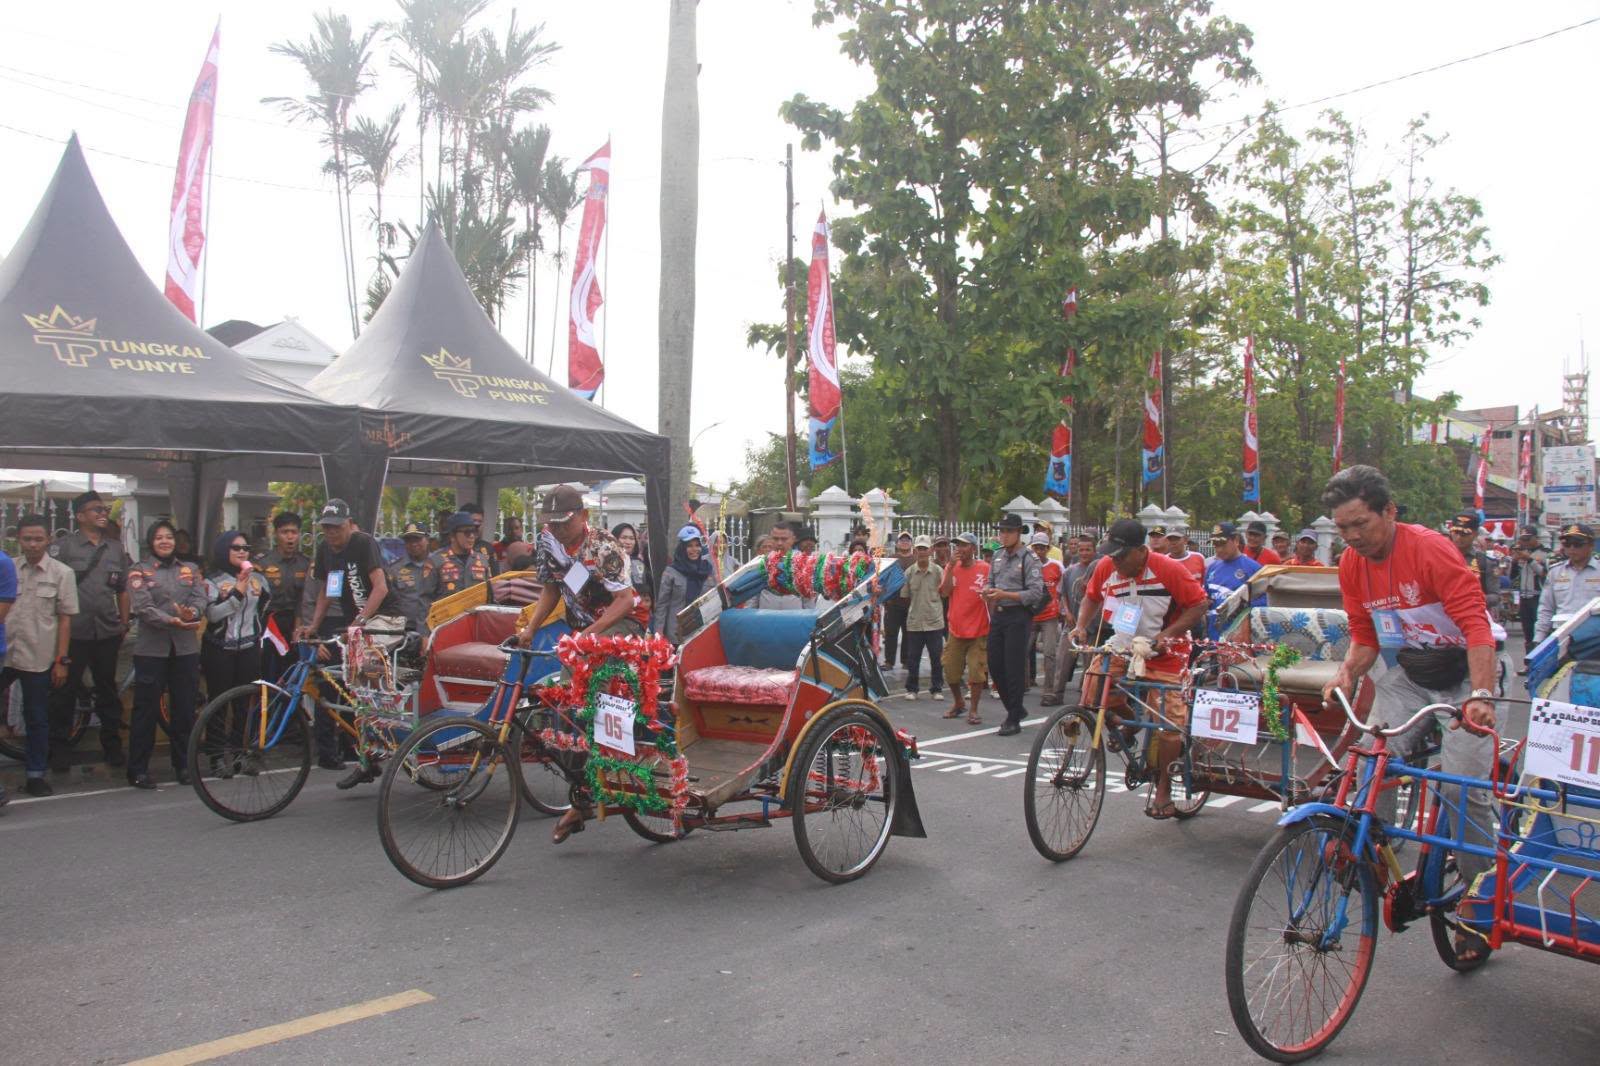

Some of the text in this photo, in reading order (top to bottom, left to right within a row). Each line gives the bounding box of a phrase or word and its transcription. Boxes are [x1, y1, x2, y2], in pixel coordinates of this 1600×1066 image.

[99, 340, 212, 360] TUNGKAL
[108, 357, 195, 375] PUNYE
[479, 375, 554, 393] TUNGKAL
[488, 390, 549, 405] PUNYE
[605, 713, 622, 740] 05
[1210, 708, 1240, 733] 02
[1570, 733, 1600, 774] 11
